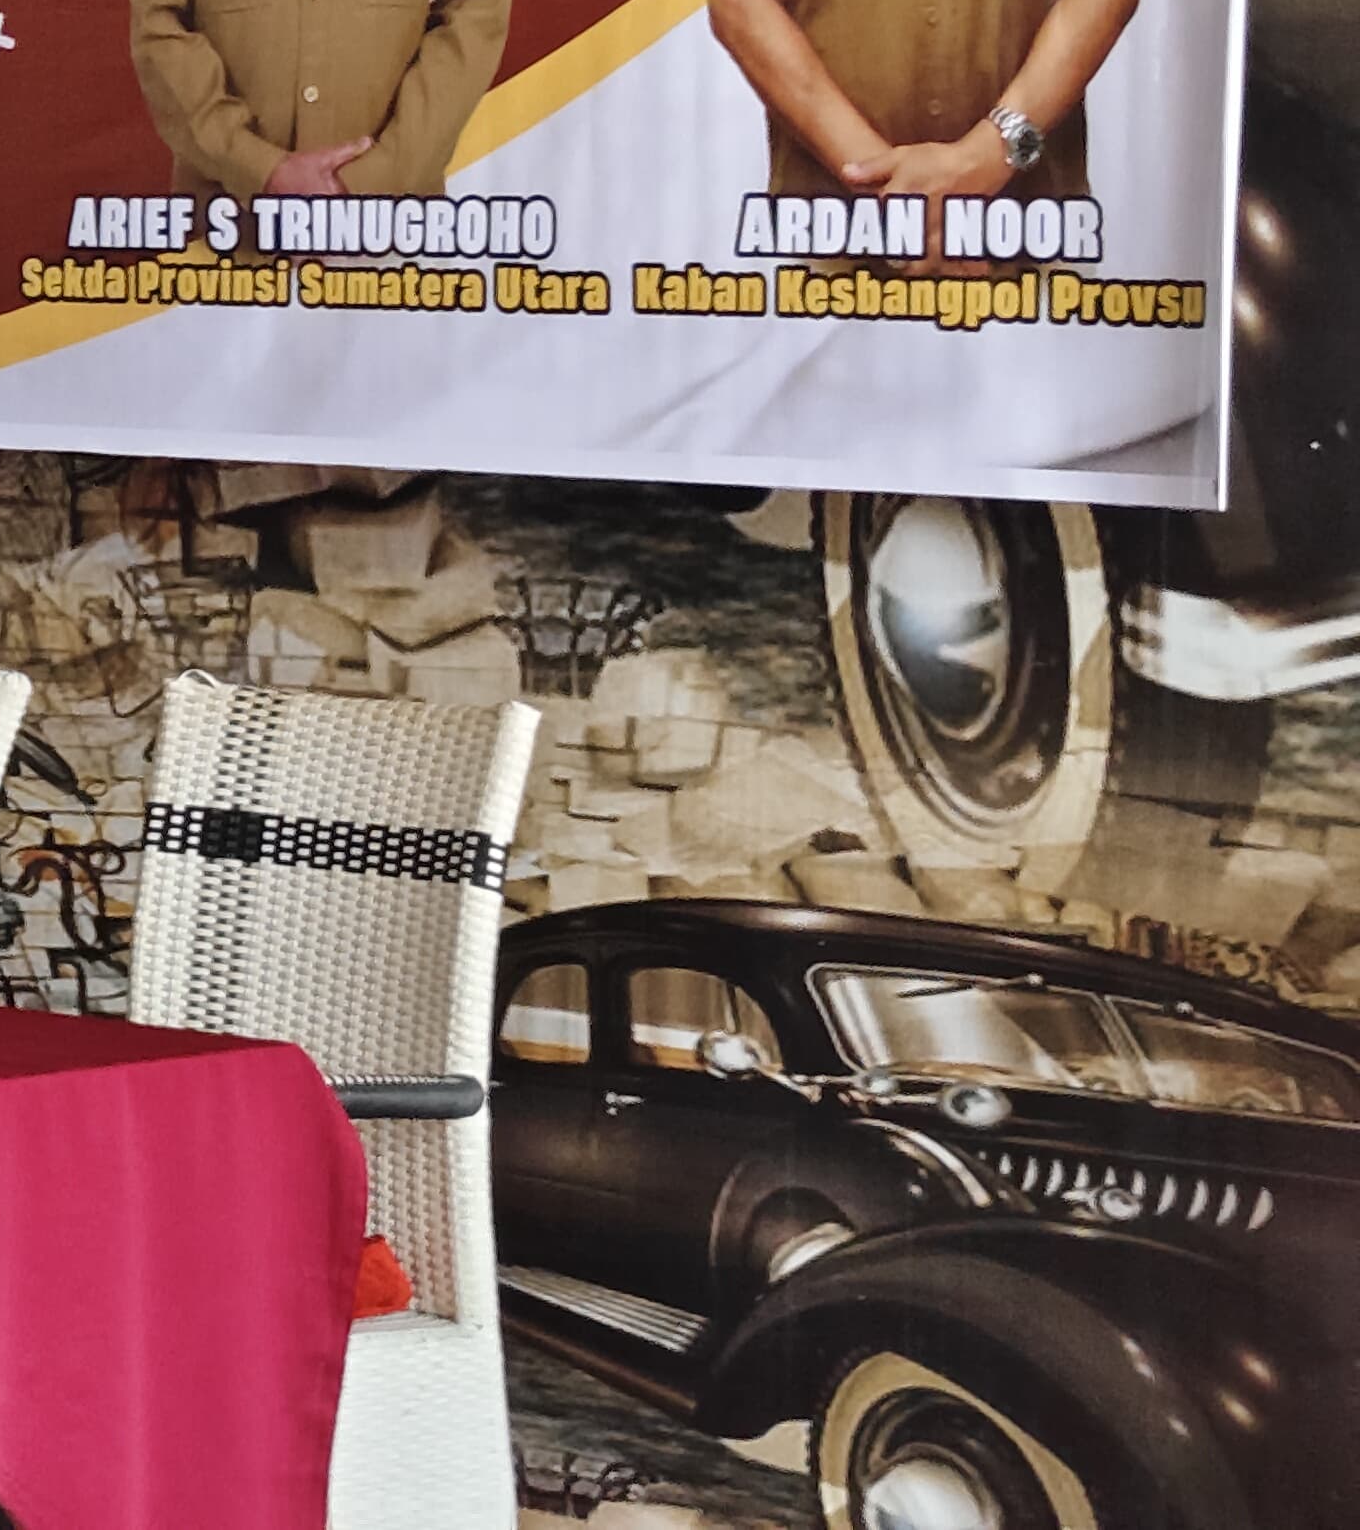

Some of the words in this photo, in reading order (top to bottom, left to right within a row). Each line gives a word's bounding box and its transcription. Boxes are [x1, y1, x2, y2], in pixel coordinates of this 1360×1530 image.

[67, 194, 194, 251] ARIEF
[206, 195, 239, 253] S
[252, 193, 557, 259] TRINUGROHO
[736, 193, 927, 259] ARDAN
[942, 194, 1103, 261] NOOR
[21, 257, 130, 303] Sekda
[137, 257, 290, 307] Provinsi
[298, 261, 483, 311] Sumatera
[494, 261, 611, 314] Utara
[633, 264, 766, 317] Kaban
[776, 265, 1038, 330] Kesbangpol
[1049, 270, 1206, 328] Provsu
